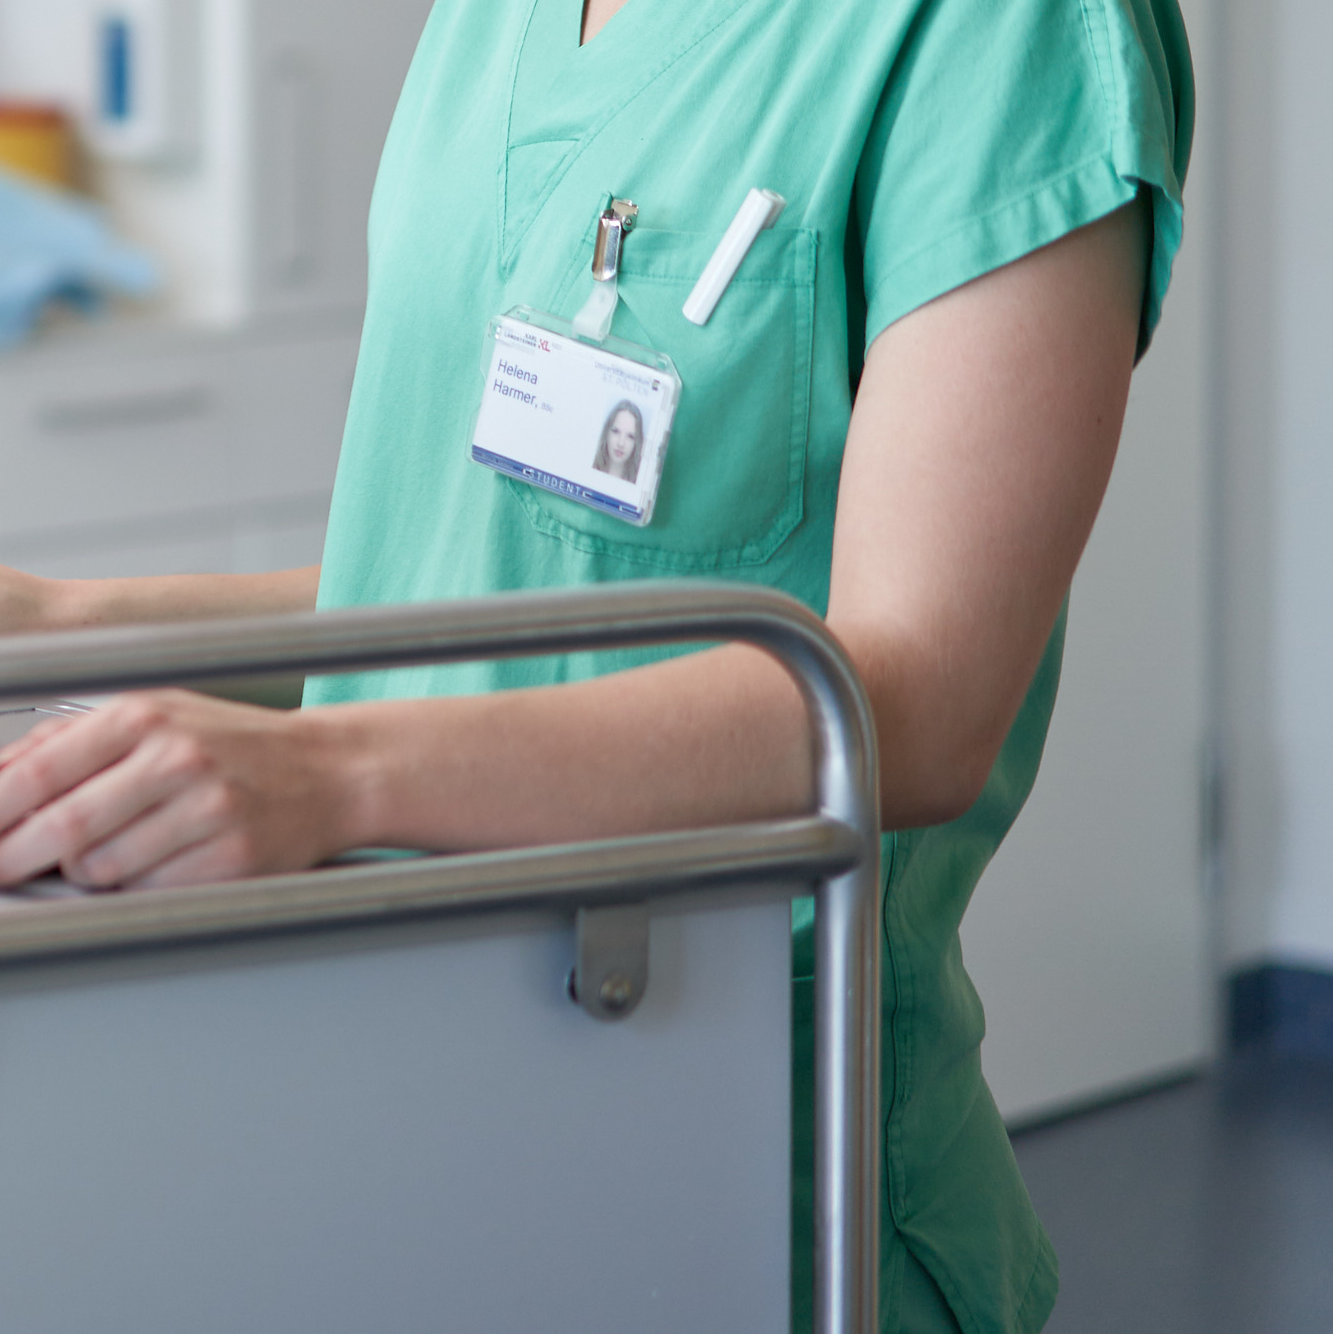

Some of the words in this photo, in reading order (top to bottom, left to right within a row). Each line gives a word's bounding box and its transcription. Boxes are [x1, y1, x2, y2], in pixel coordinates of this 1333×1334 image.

[497, 358, 538, 385] Helena
[493, 378, 538, 409] Harmer,
[528, 468, 583, 496] STUDENT
